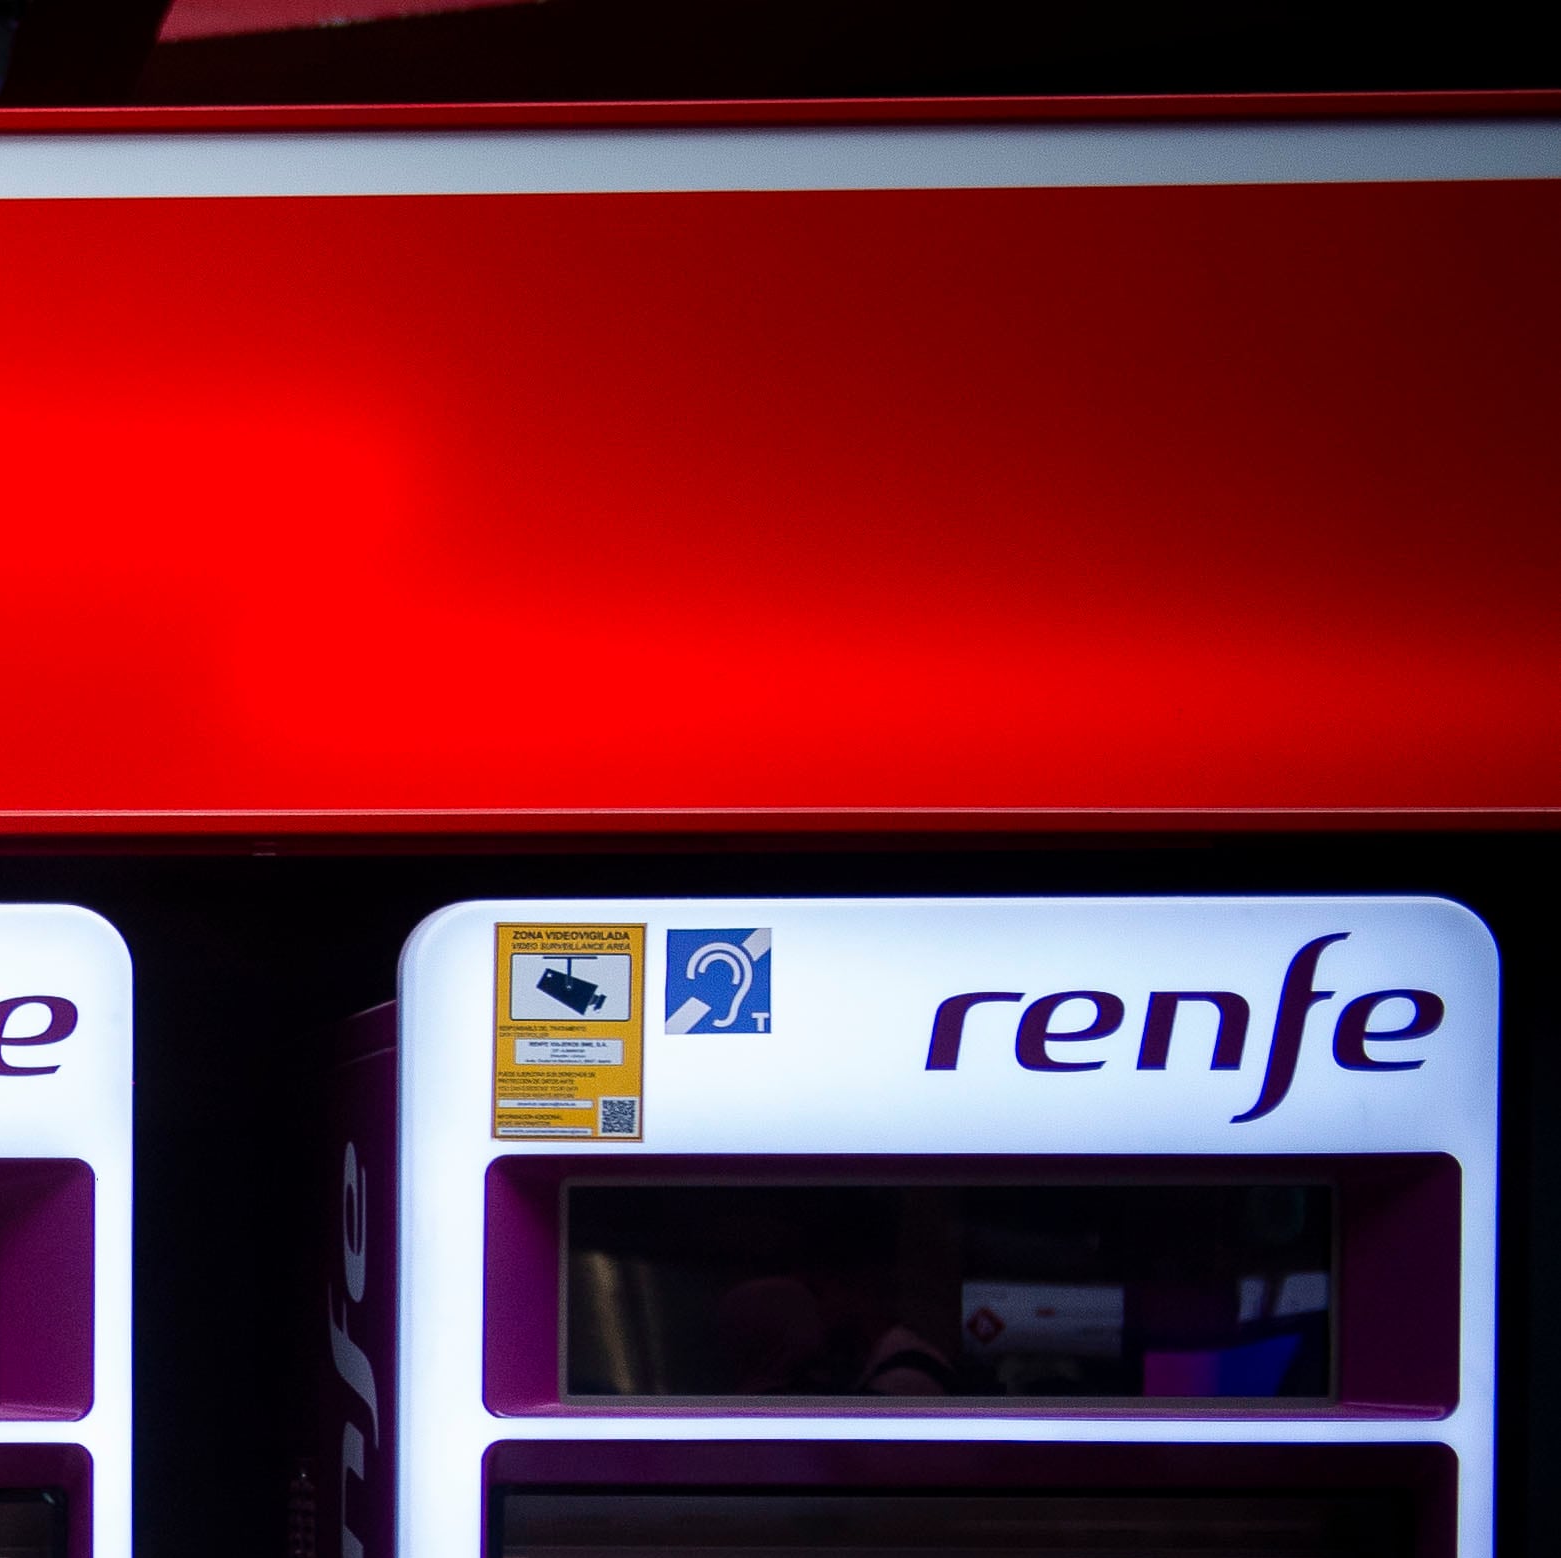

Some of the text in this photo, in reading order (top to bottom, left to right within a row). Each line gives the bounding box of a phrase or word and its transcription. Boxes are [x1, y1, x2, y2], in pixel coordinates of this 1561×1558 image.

[513, 931, 630, 940] ZONA VIDEOVIGILADA
[752, 1012, 769, 1032] T
[925, 932, 1444, 1123] renfe
